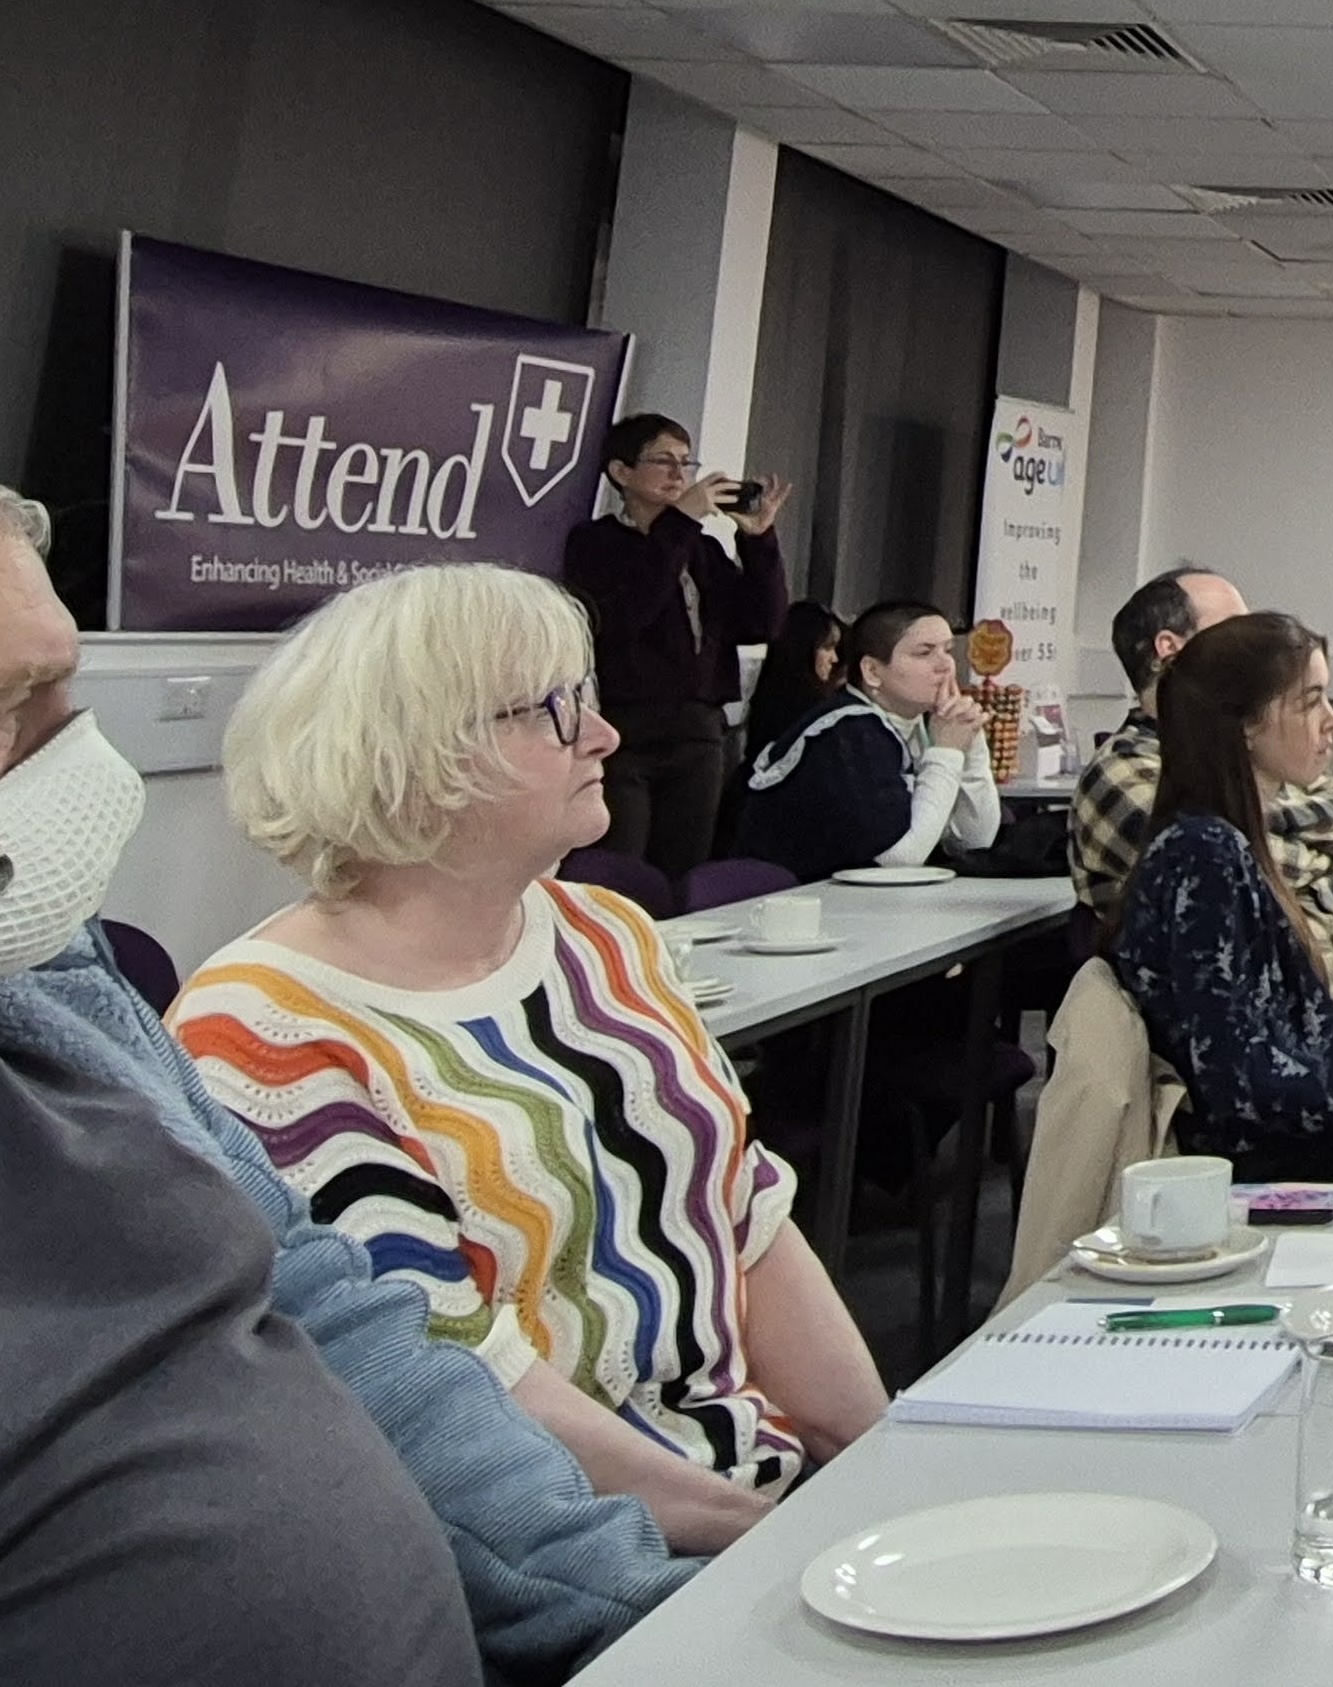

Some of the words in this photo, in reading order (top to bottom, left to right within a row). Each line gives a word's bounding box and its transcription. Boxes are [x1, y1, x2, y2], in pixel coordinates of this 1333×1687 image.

[155, 361, 495, 539] Attend
[1004, 519, 1060, 546] Improving
[190, 555, 281, 591] Enhancing
[283, 559, 334, 585] Health
[336, 560, 349, 585] &
[1018, 560, 1038, 581] the
[1000, 601, 1056, 625] wellbeing
